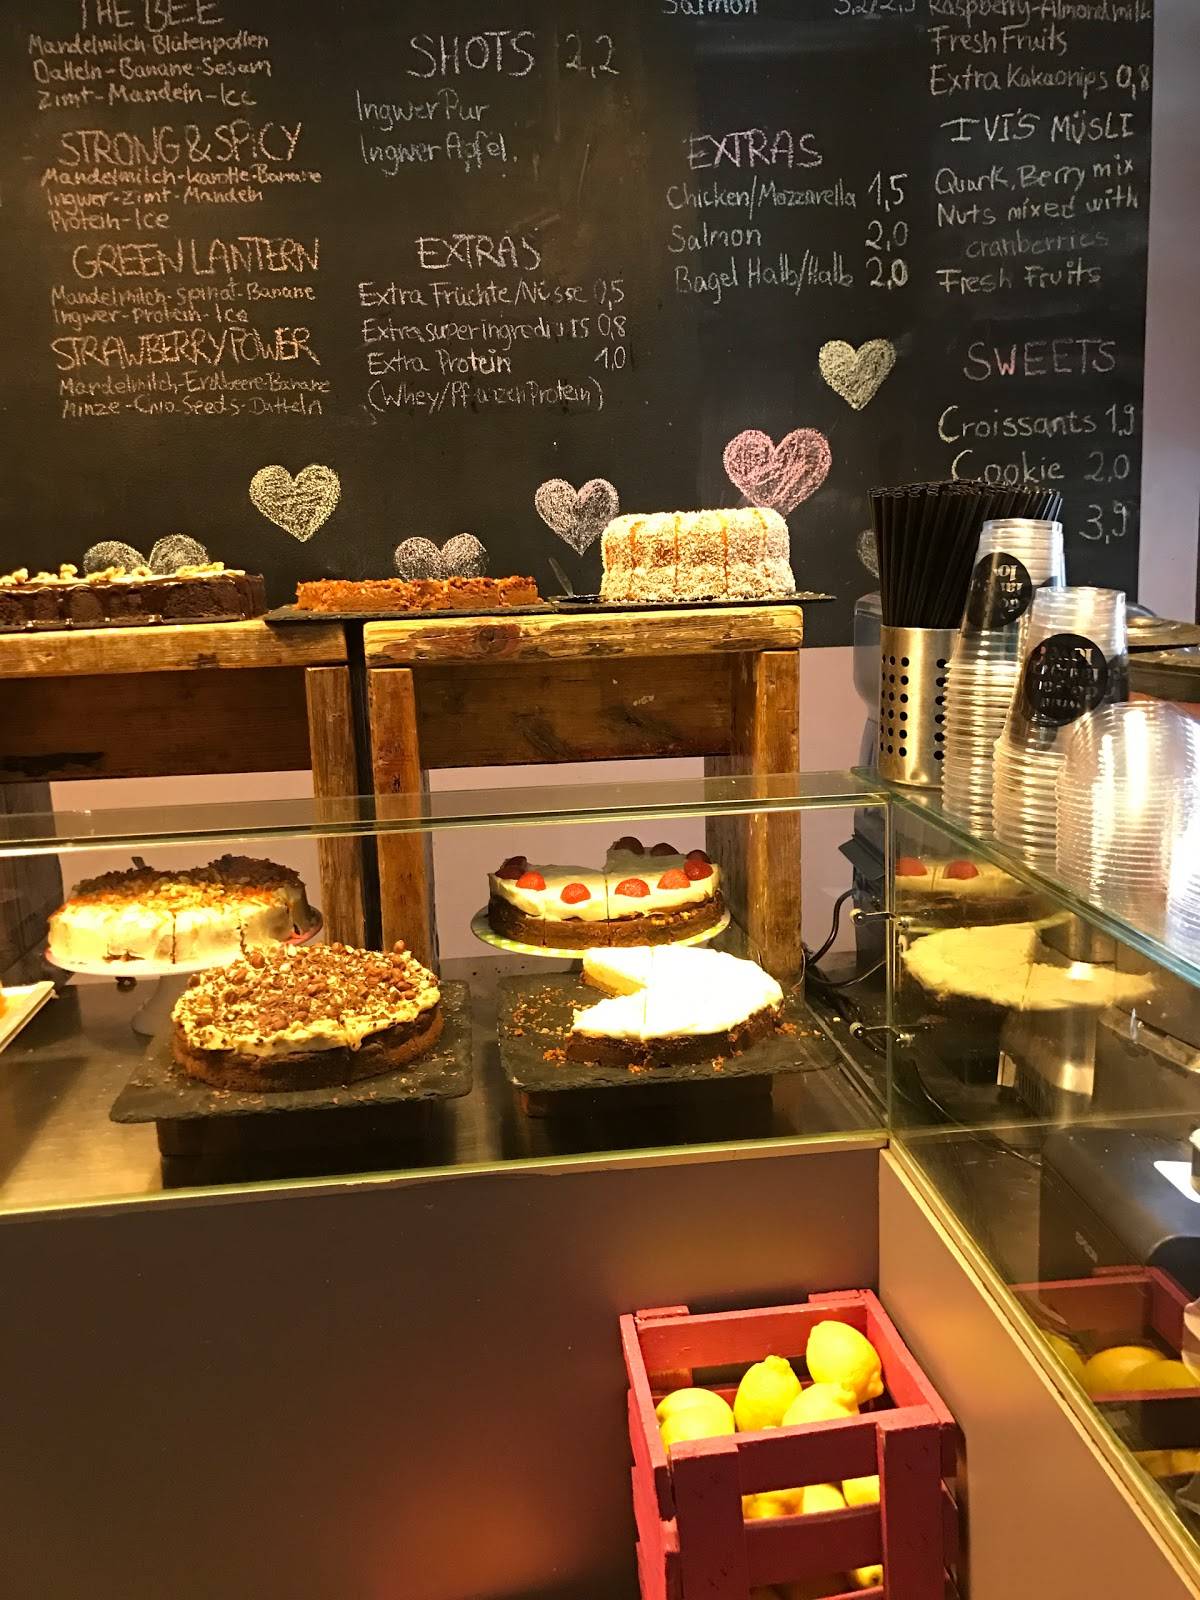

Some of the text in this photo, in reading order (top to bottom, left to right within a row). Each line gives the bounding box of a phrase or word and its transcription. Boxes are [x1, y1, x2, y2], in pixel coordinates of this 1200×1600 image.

[407, 31, 620, 78] SHOTS 2,2
[927, 23, 1068, 56] Fresh Fruits
[929, 63, 1002, 96] Extra
[1007, 63, 1108, 101] Kakaonips
[357, 87, 490, 131] Ingwer Pur
[60, 126, 180, 167] STRONG
[186, 124, 213, 160] &
[360, 135, 441, 176] Ingwer
[683, 128, 822, 169] EXTRAS
[868, 171, 909, 213] 1,5
[1017, 164, 1085, 192] Berry
[1093, 152, 1134, 178] mix
[938, 185, 1139, 227] Nuts mixed with
[667, 219, 909, 253] Salmon 2,0
[72, 236, 319, 279] GREEN LANTERN
[936, 257, 1101, 294] Fresh Fruits
[359, 281, 428, 307] Extra
[674, 256, 739, 304] Bagel
[866, 257, 909, 290] 2,0
[597, 313, 628, 342] 0,8
[368, 346, 627, 376] Extra Protein 1,0
[963, 338, 1117, 381] SWEETS
[938, 404, 1098, 443] Croissants
[952, 449, 1130, 485] Cookie 2,0
[1079, 500, 1129, 545] 3,9
